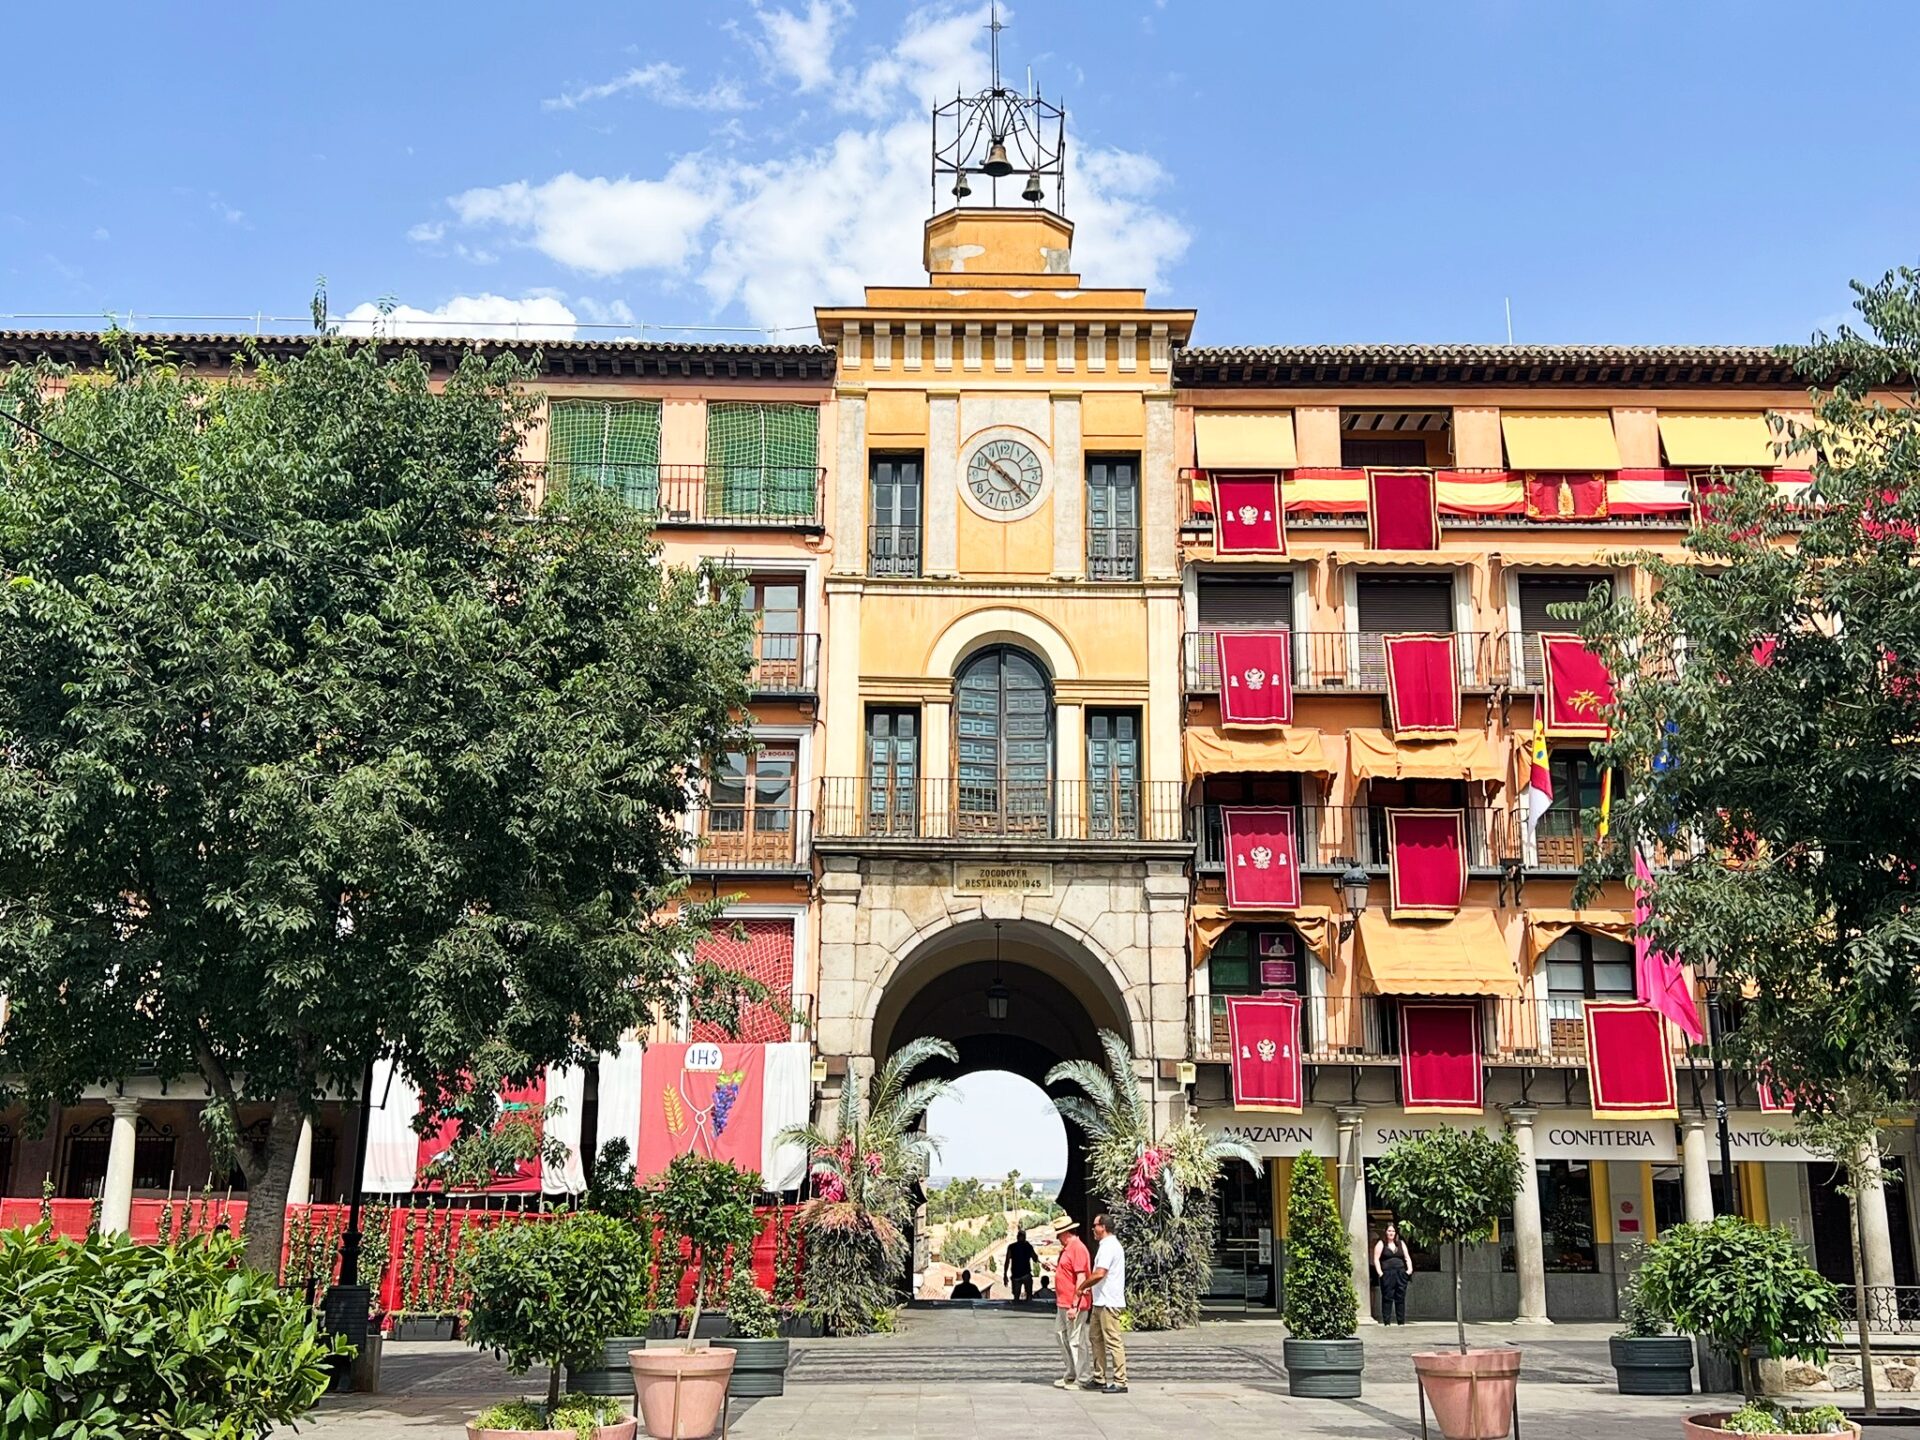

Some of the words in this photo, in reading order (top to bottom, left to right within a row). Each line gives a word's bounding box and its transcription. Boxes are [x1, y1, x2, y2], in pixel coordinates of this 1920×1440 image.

[1000, 444, 1010, 455] 12
[977, 456, 987, 467] 10
[1027, 457, 1034, 467] 2
[972, 470, 979, 479] 9
[1031, 470, 1038, 480] 3
[976, 483, 984, 494] 8
[988, 492, 995, 503] 7
[1001, 495, 1008, 506] 6
[1015, 493, 1022, 504] 5
[980, 868, 1028, 878] ZOCODOVER
[965, 879, 1019, 889] RESTAURADO
[1022, 879, 1042, 889] 1945
[1548, 1129, 1656, 1146] CONFITERIA
